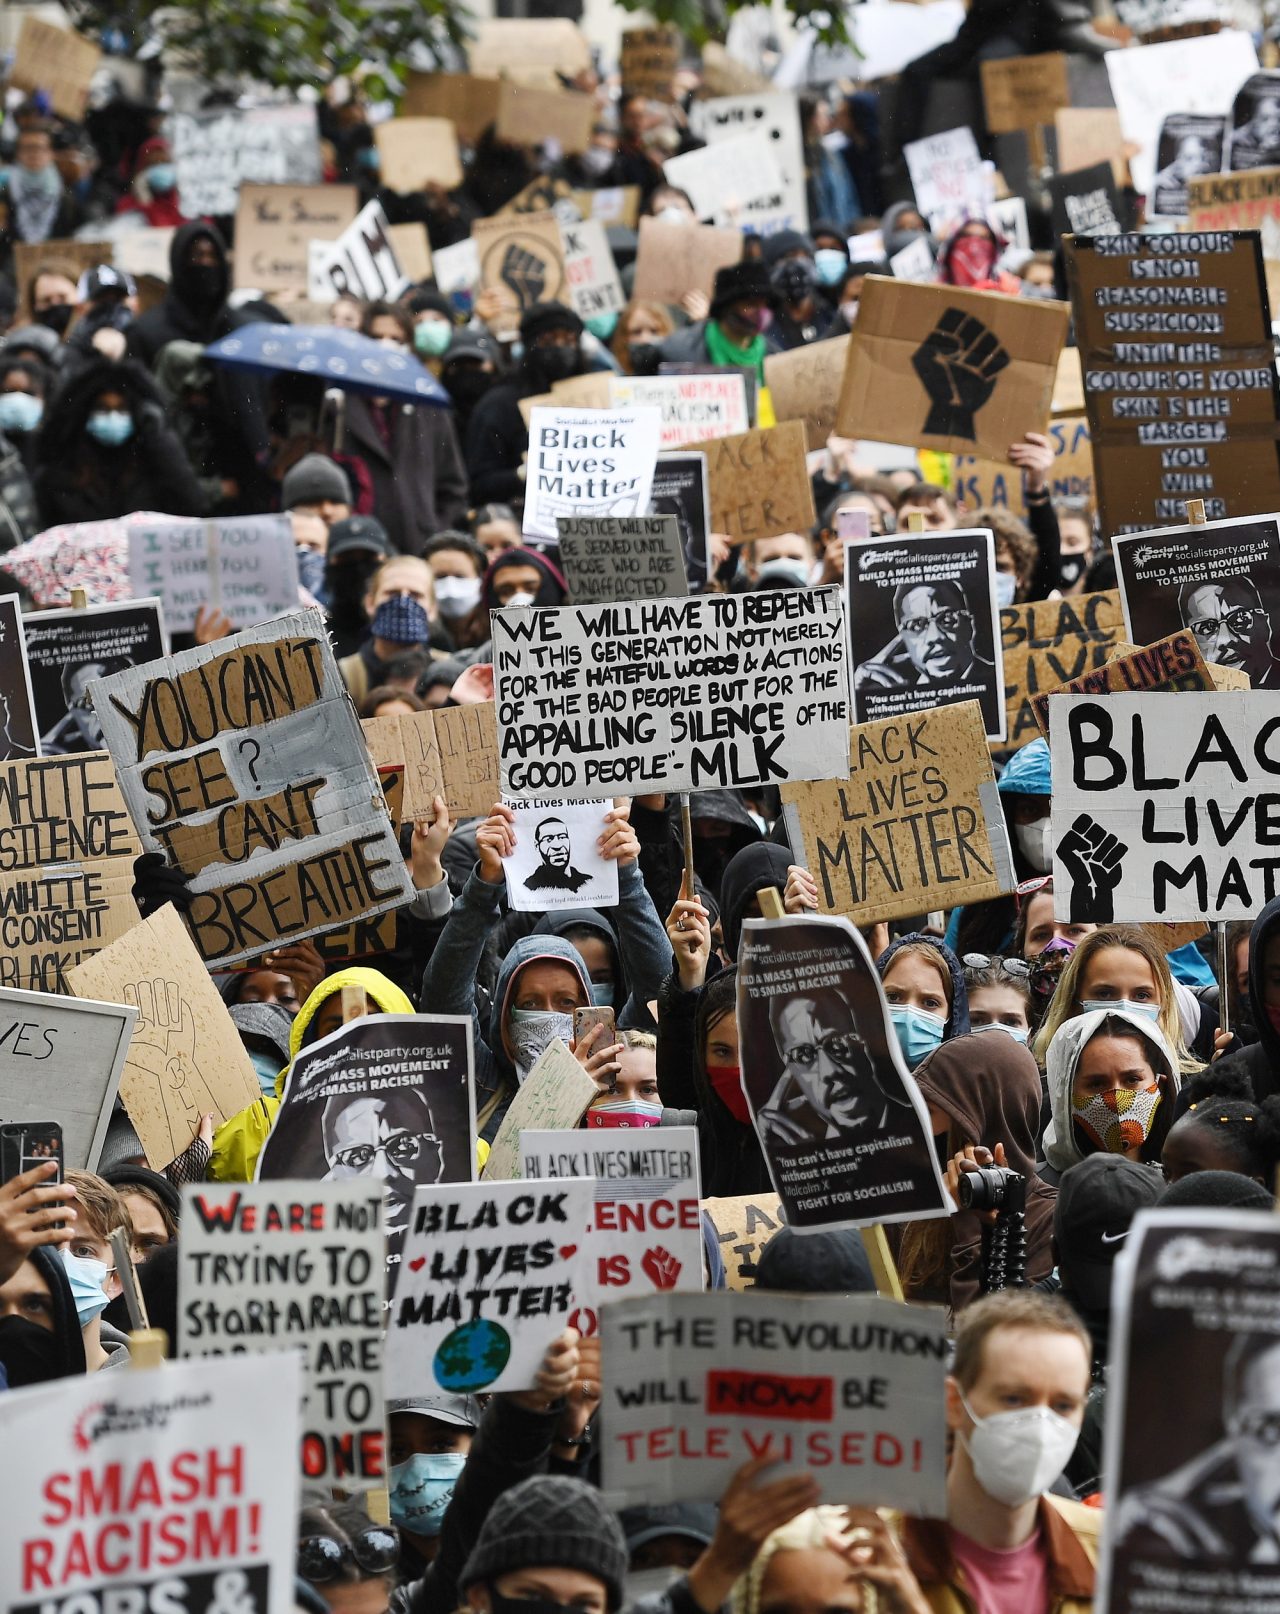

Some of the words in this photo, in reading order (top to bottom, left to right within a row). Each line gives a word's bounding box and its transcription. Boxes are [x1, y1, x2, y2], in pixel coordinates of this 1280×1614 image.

[1094, 235, 1140, 254] SKIN
[1150, 234, 1232, 252] COLOUR
[1131, 260, 1148, 278] IS
[1155, 260, 1198, 277] NOT
[1096, 288, 1226, 305] REASONABLE
[1114, 344, 1174, 362] UNTIL
[1180, 344, 1220, 362] THE
[1088, 371, 1171, 390] COLOUR
[1176, 371, 1202, 389] OF
[1210, 369, 1271, 388] YOUR
[1114, 398, 1159, 416] SKIN
[1168, 398, 1184, 415] IS
[1188, 398, 1230, 415] THE
[540, 428, 625, 448] Black
[1162, 449, 1208, 466] YOU
[539, 452, 615, 473] Lives
[1162, 474, 1212, 490] WILL
[538, 476, 640, 498] Matter
[560, 520, 615, 535] JUSTICE
[618, 521, 642, 534] WILL
[645, 519, 668, 534] NOT
[561, 539, 580, 555] BE
[585, 540, 631, 553] SERVED
[634, 539, 670, 554] UNTIL
[562, 559, 603, 575] THOSE
[612, 557, 641, 572] WHO
[649, 557, 675, 573] ARE
[576, 610, 639, 638] WILL
[642, 602, 702, 632] HAVE
[709, 599, 737, 627] TO
[743, 589, 832, 623] REPENT
[499, 650, 521, 670] IN
[530, 646, 582, 667] THIS
[591, 632, 718, 661] GENERATION
[726, 627, 770, 650] NOT
[772, 619, 841, 645] MERELY
[109, 666, 219, 761] YOU
[219, 639, 322, 730] CAN'T
[142, 748, 237, 825] SEE
[838, 768, 948, 821] LIVES
[218, 778, 327, 861] CAN'T
[0, 812, 131, 871] SILENCE
[817, 805, 993, 908] MATTER
[0, 873, 109, 915] WHITE
[191, 833, 402, 959] BREATHE
[2, 906, 109, 948] CONSENT
[265, 1204, 325, 1233] ARE
[335, 1197, 382, 1232] NOT
[414, 1192, 568, 1236] BLACK
[323, 1246, 370, 1286] TO
[428, 1240, 556, 1280] LIVES
[396, 1283, 573, 1328] MATTER
[620, 1318, 717, 1349] THE
[732, 1316, 946, 1359] REVOLUTION
[615, 1377, 698, 1408] WILL
[717, 1380, 824, 1408] NOW
[842, 1377, 889, 1409] BE
[617, 1425, 922, 1472] TELEVISED!
[42, 1444, 243, 1528] SMASH
[21, 1503, 262, 1592] RACISM!
